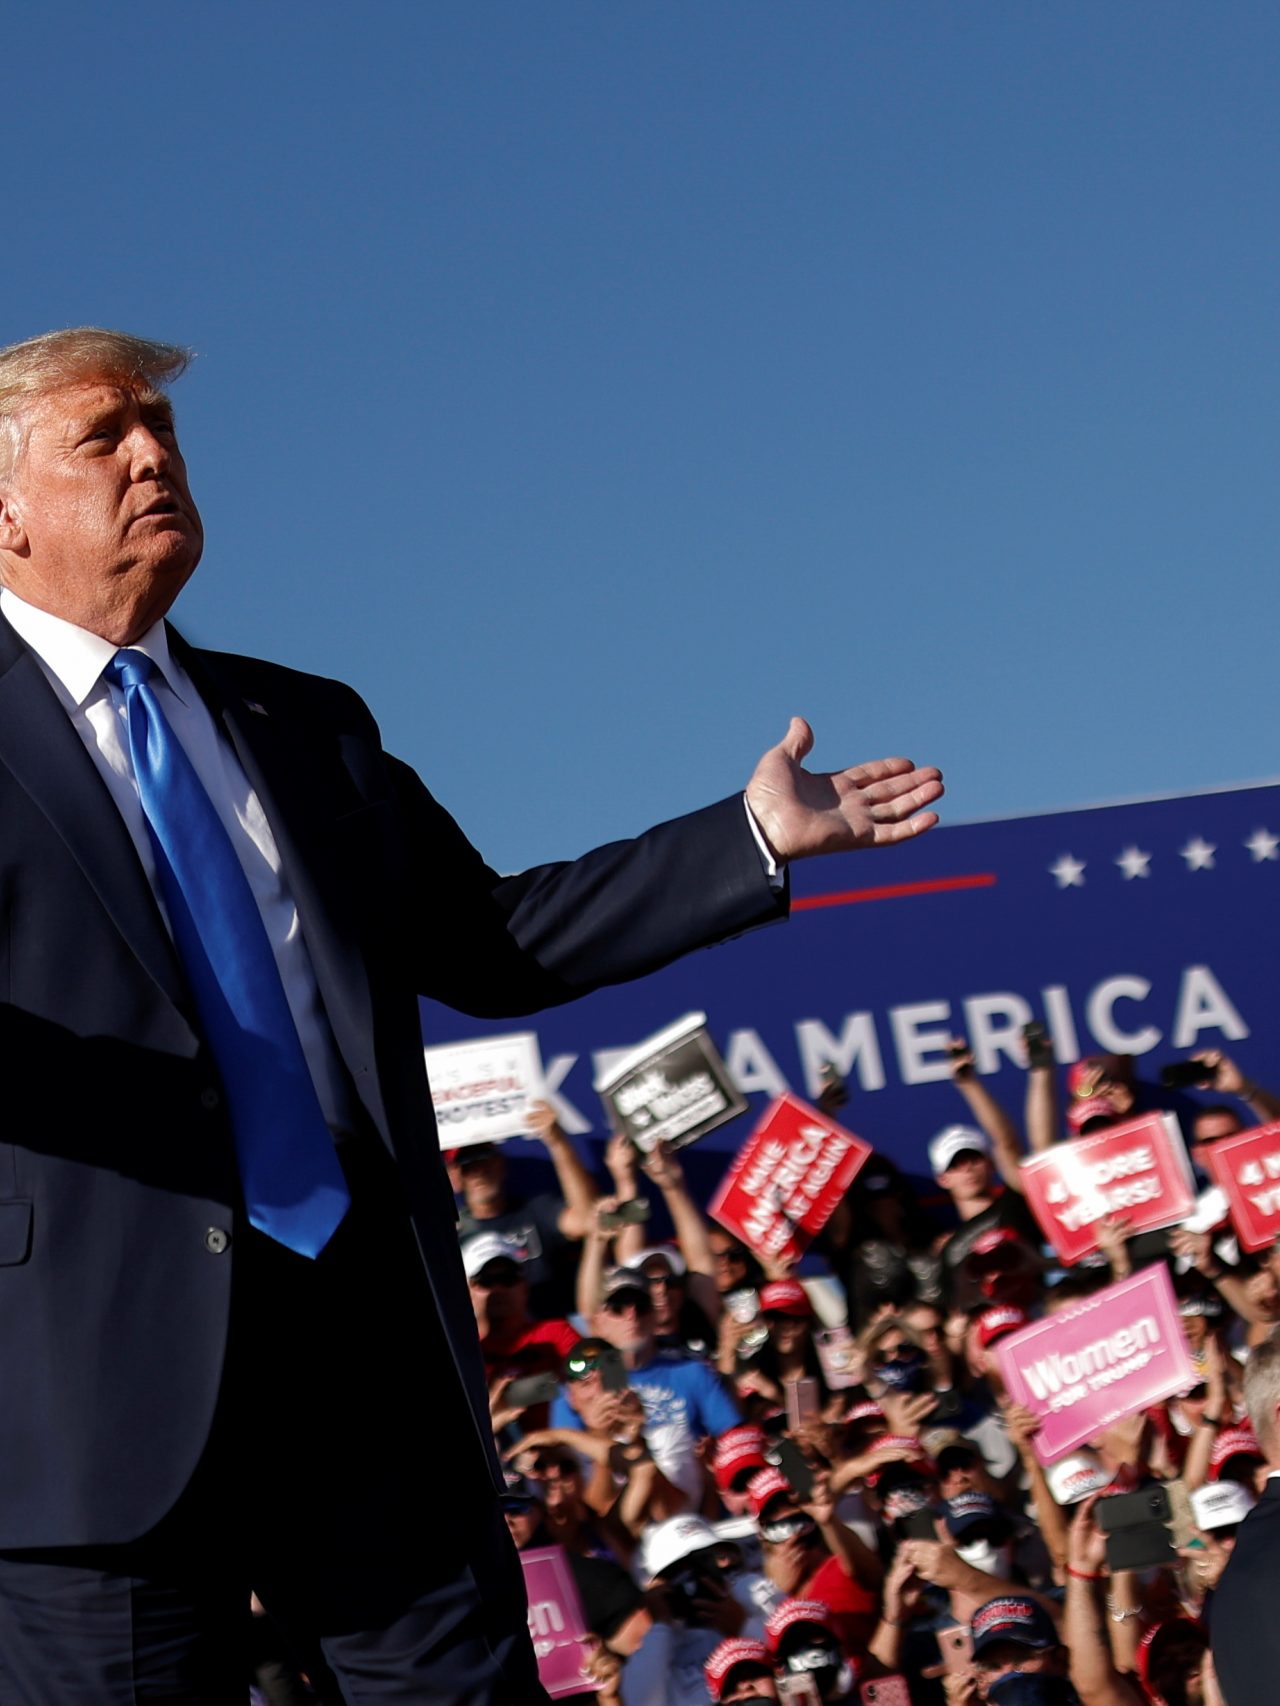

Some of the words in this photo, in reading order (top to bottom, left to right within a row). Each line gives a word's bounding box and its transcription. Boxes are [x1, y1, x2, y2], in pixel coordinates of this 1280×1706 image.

[724, 964, 1250, 1095] AMERICA
[431, 1074, 524, 1105] EACEFUL
[436, 1093, 527, 1125] ROTEST
[739, 1141, 786, 1196] MAKE
[742, 1125, 830, 1244] AMERICA
[800, 1137, 849, 1198] AGAIN
[1046, 1180, 1070, 1204] 4
[1071, 1145, 1157, 1193] ORE
[1055, 1175, 1163, 1231] YERS!
[1022, 1316, 1161, 1401] Women
[1087, 1350, 1153, 1391] TRUMP
